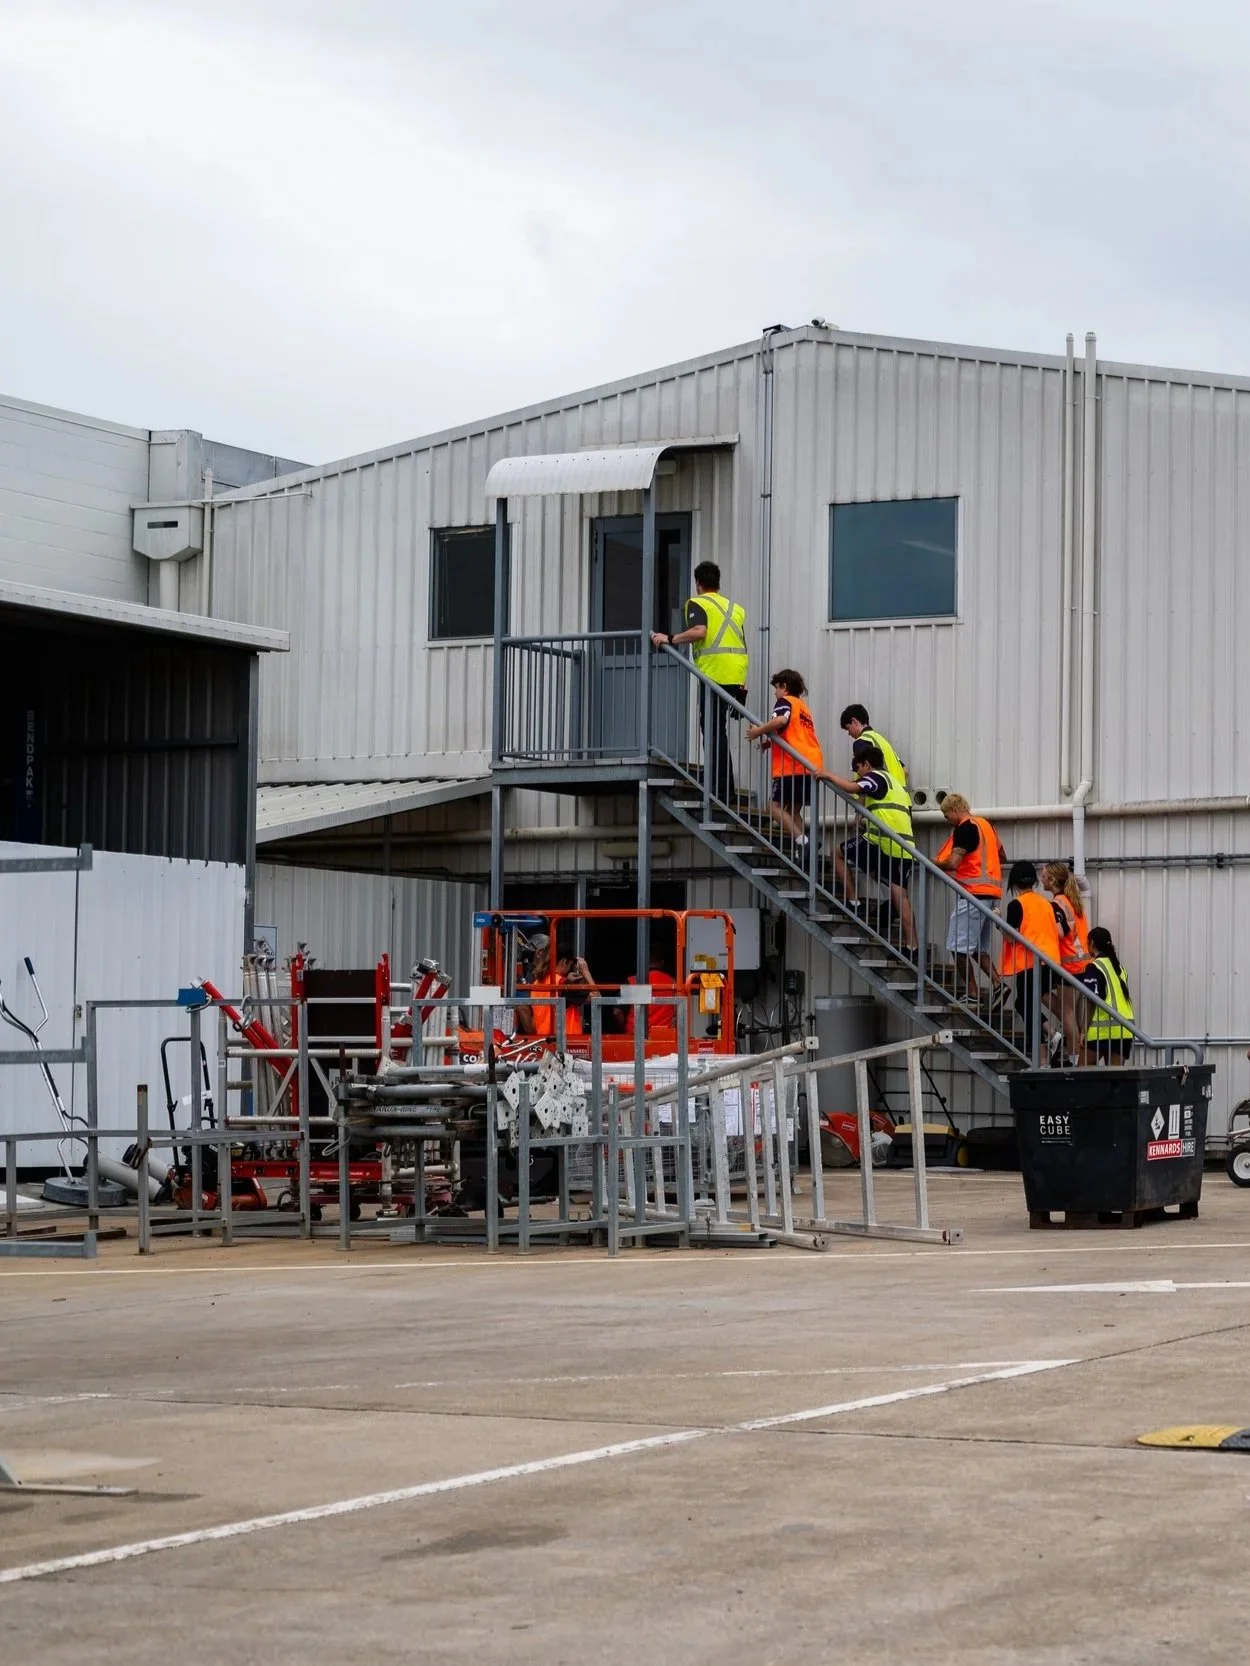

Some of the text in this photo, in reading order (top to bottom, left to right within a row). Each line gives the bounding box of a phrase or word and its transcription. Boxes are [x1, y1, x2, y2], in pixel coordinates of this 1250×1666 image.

[1039, 1115, 1069, 1125] EASY
[1039, 1125, 1071, 1135] CUBE
[1149, 1141, 1195, 1157] KENNARDS HIRE
